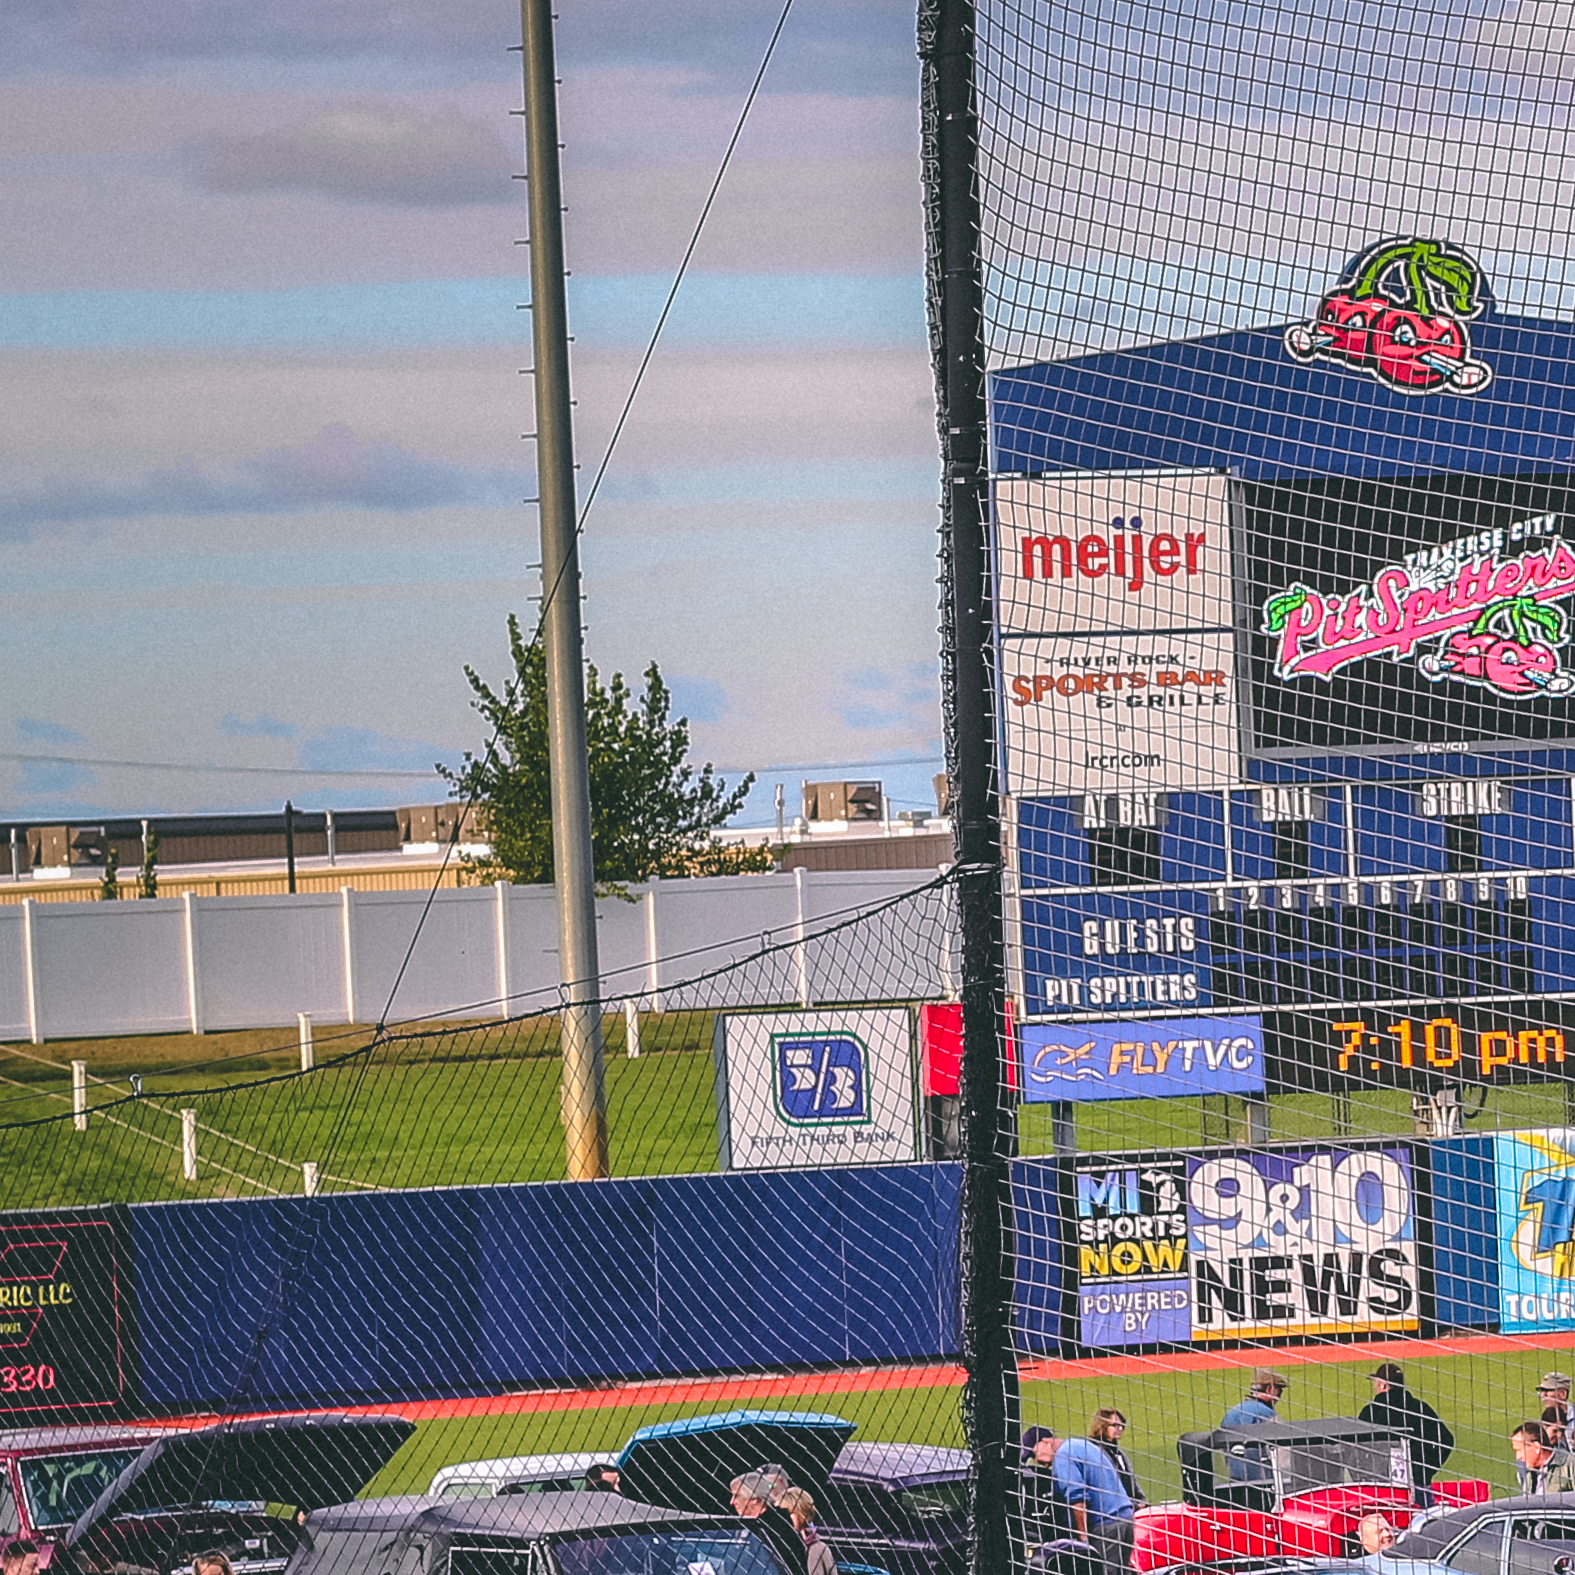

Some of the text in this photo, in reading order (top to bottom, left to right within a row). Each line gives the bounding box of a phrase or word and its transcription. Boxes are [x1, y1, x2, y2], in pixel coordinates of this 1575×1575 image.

[1021, 516, 1206, 592] meijer
[1403, 514, 1558, 568] TRAVERSE CITY
[1277, 584, 1368, 669] Pit
[1059, 653, 1181, 668] RIVER ROCK
[1012, 670, 1227, 707] SPORTS BAR
[1126, 692, 1227, 708] GRILLE
[1083, 792, 1160, 829] AT BAT
[1262, 787, 1316, 822] BALL
[1422, 780, 1502, 818] STRIKE
[1216, 876, 1527, 911] 1 2 3 4 5 6 7 8 9 10
[1081, 916, 1196, 957] GUESTS
[1045, 972, 1198, 1006] PIT SPITTERS
[1333, 1018, 1565, 1076] 7:10 pm
[751, 1130, 896, 1150] FIFTH THIRD BANK
[1077, 1170, 1141, 1217] MI
[1190, 1150, 1410, 1250] 9&10
[1079, 1213, 1187, 1242] SPORTS
[1080, 1238, 1188, 1277] NOW
[38, 1283, 73, 1306] LLC
[1083, 1289, 1188, 1316] POWERED
[1196, 1249, 1413, 1324] NEWS
[1123, 1310, 1150, 1333] BY
